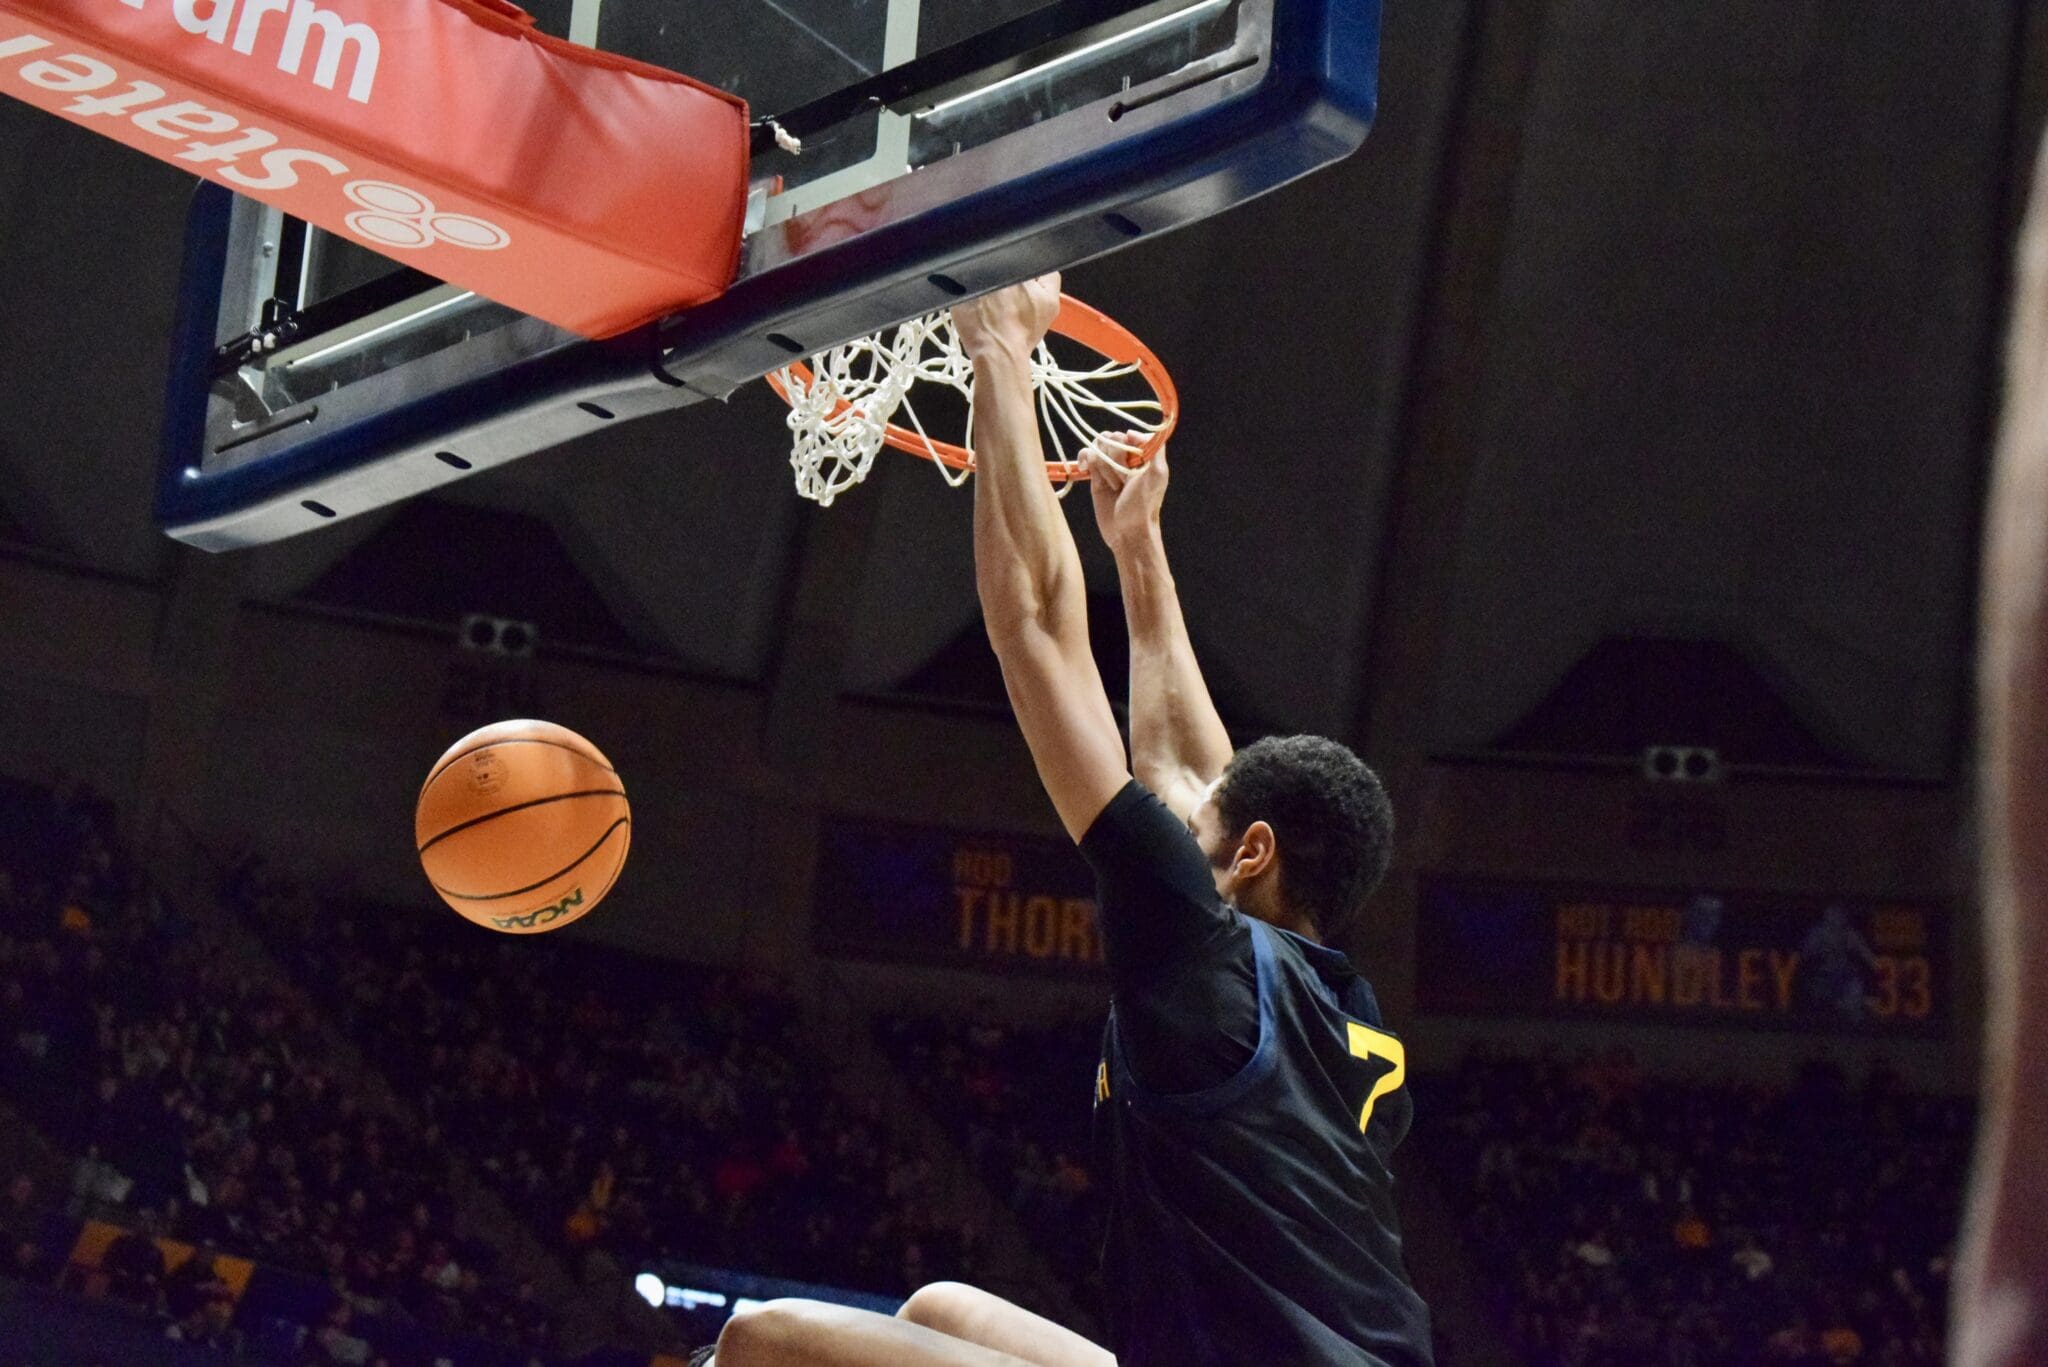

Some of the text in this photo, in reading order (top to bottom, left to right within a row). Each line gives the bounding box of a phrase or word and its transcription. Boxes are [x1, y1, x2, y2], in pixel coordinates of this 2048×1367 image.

[120, 0, 380, 104] arm
[19, 53, 350, 190] State
[491, 888, 584, 929] NCAA
[954, 887, 1105, 962] THOR
[1557, 942, 1931, 1019] HUNDLEY 33
[1347, 1021, 1407, 1135] 7
